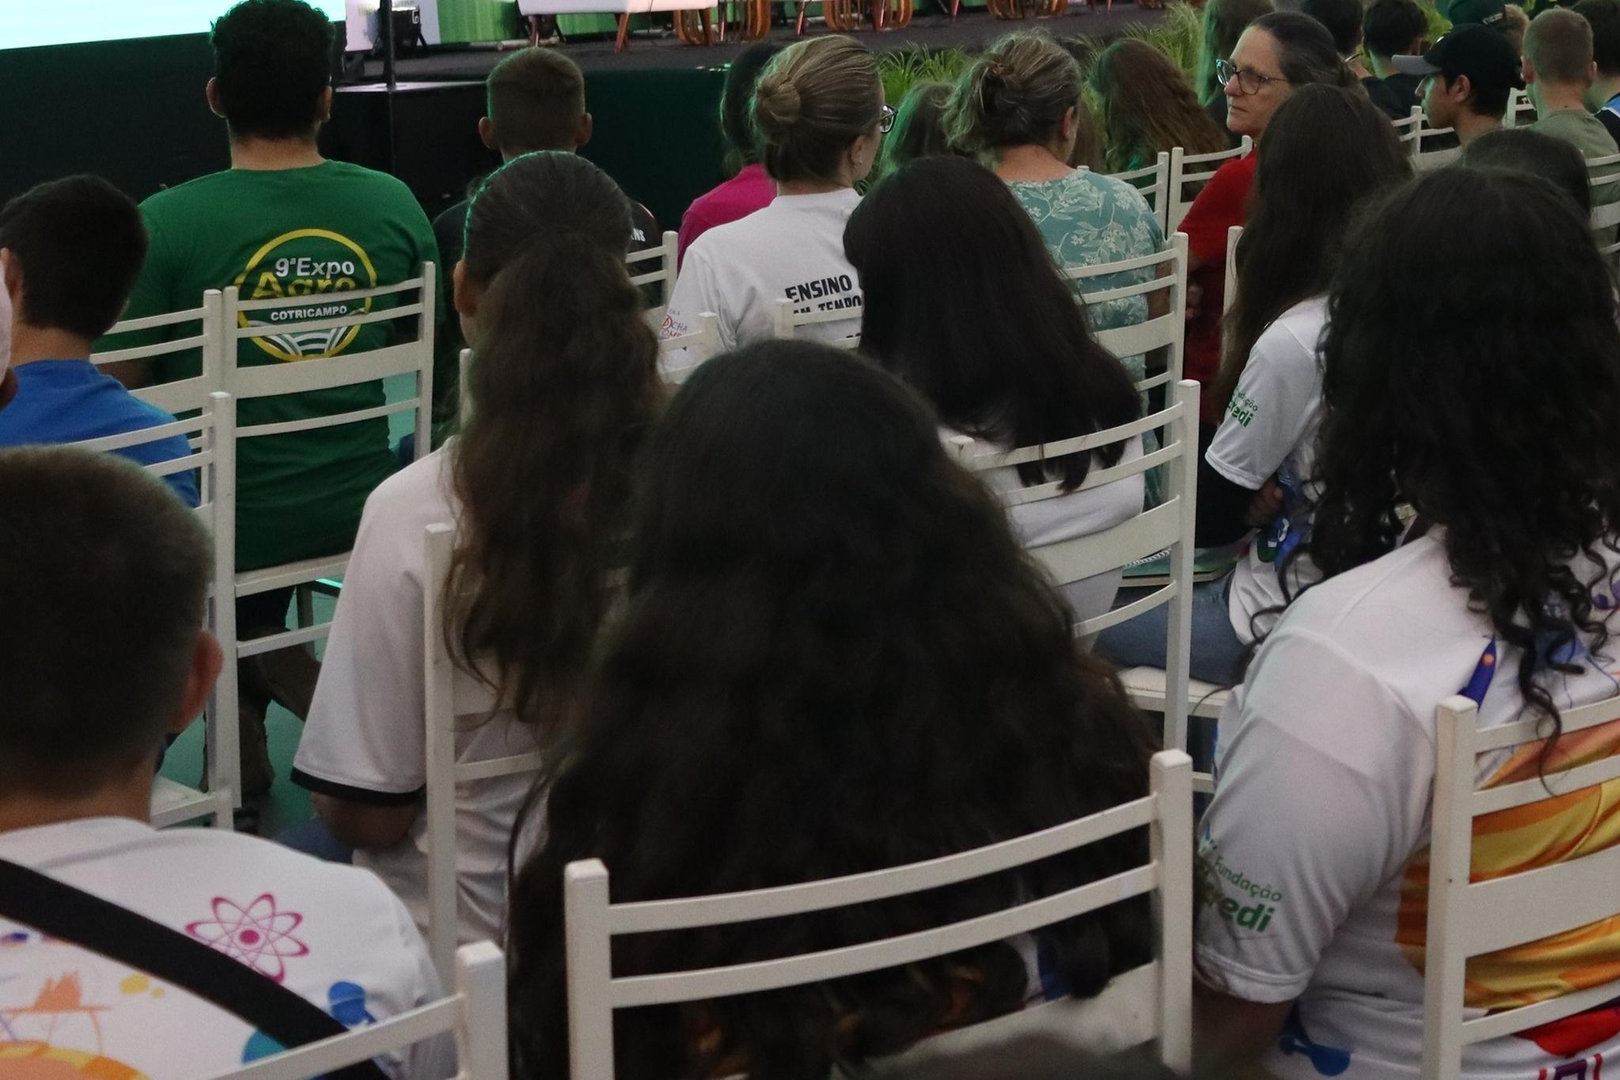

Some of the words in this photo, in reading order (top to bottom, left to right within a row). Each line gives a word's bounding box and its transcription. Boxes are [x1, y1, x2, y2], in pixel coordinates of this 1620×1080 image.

[784, 274, 852, 304] ENSINO
[270, 305, 347, 321] COTRICAMPO
[1215, 856, 1282, 902] Fundação
